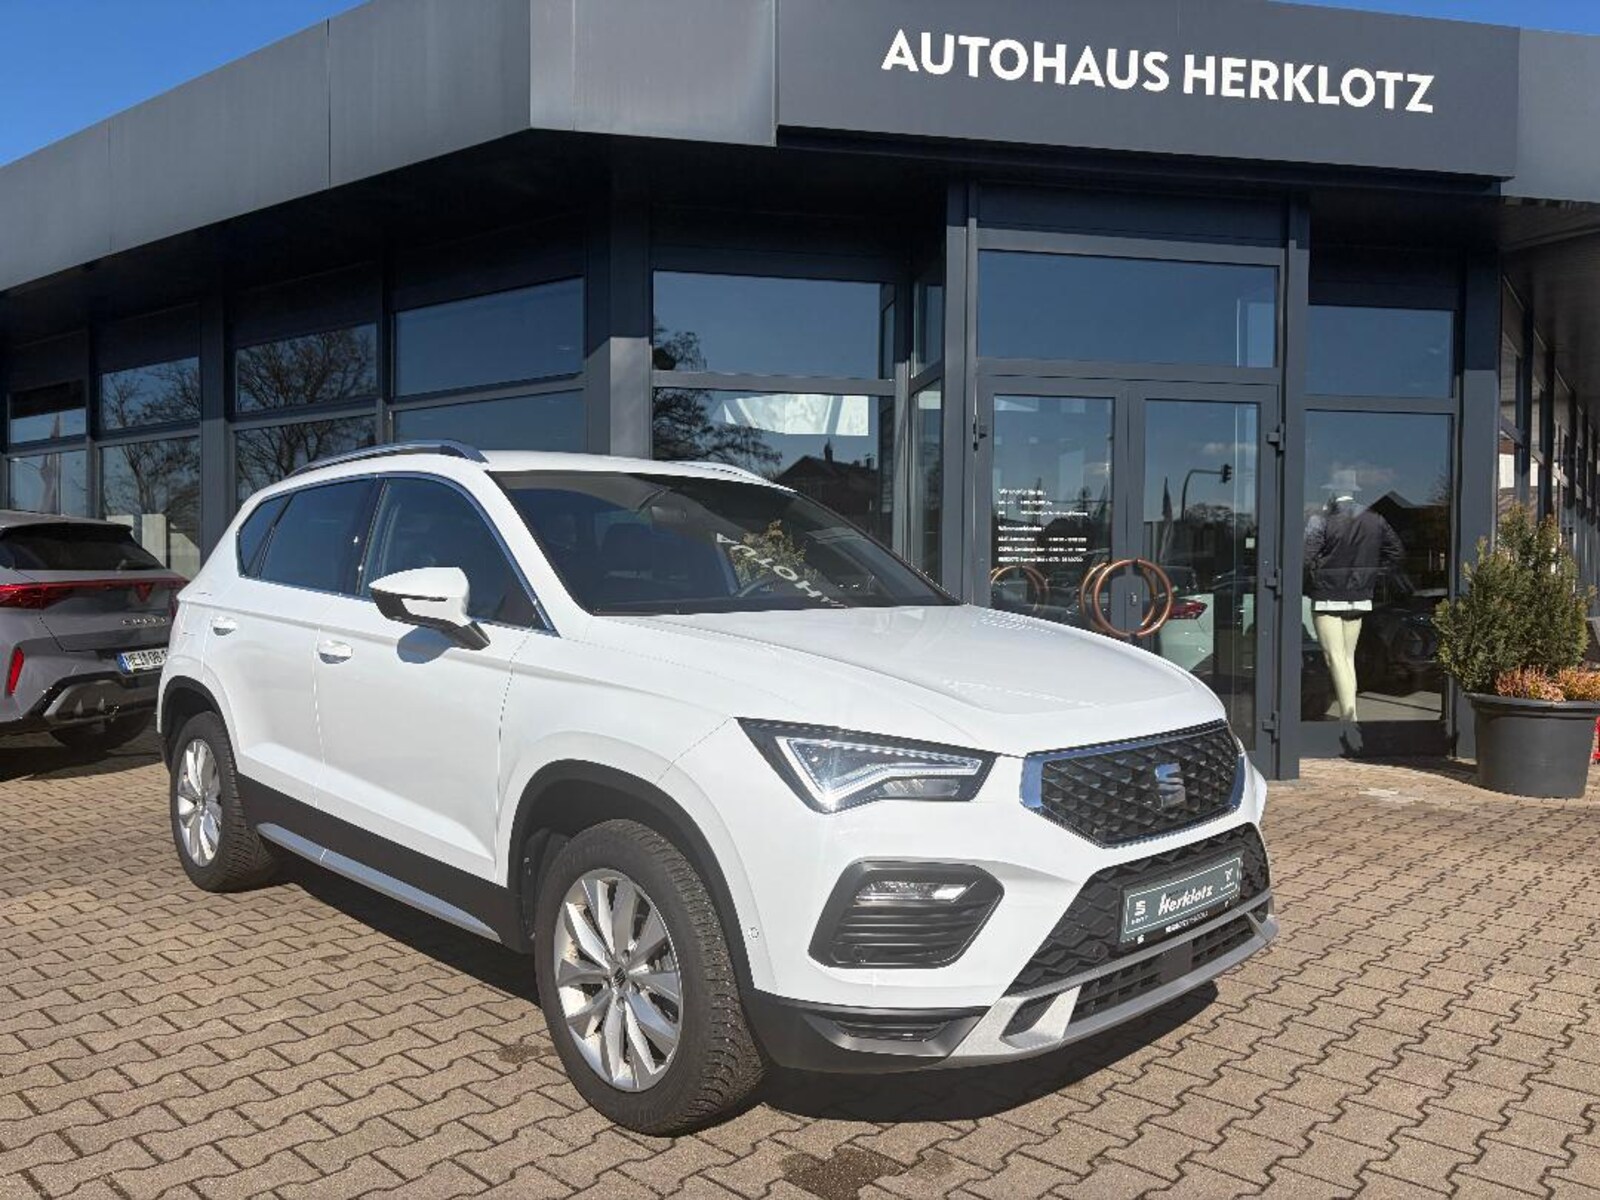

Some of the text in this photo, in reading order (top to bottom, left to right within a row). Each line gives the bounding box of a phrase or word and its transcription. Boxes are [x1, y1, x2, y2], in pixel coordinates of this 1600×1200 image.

[881, 29, 1435, 114] AUTOHAUS HERKLOTZ
[1158, 885, 1213, 916] Herklotz
